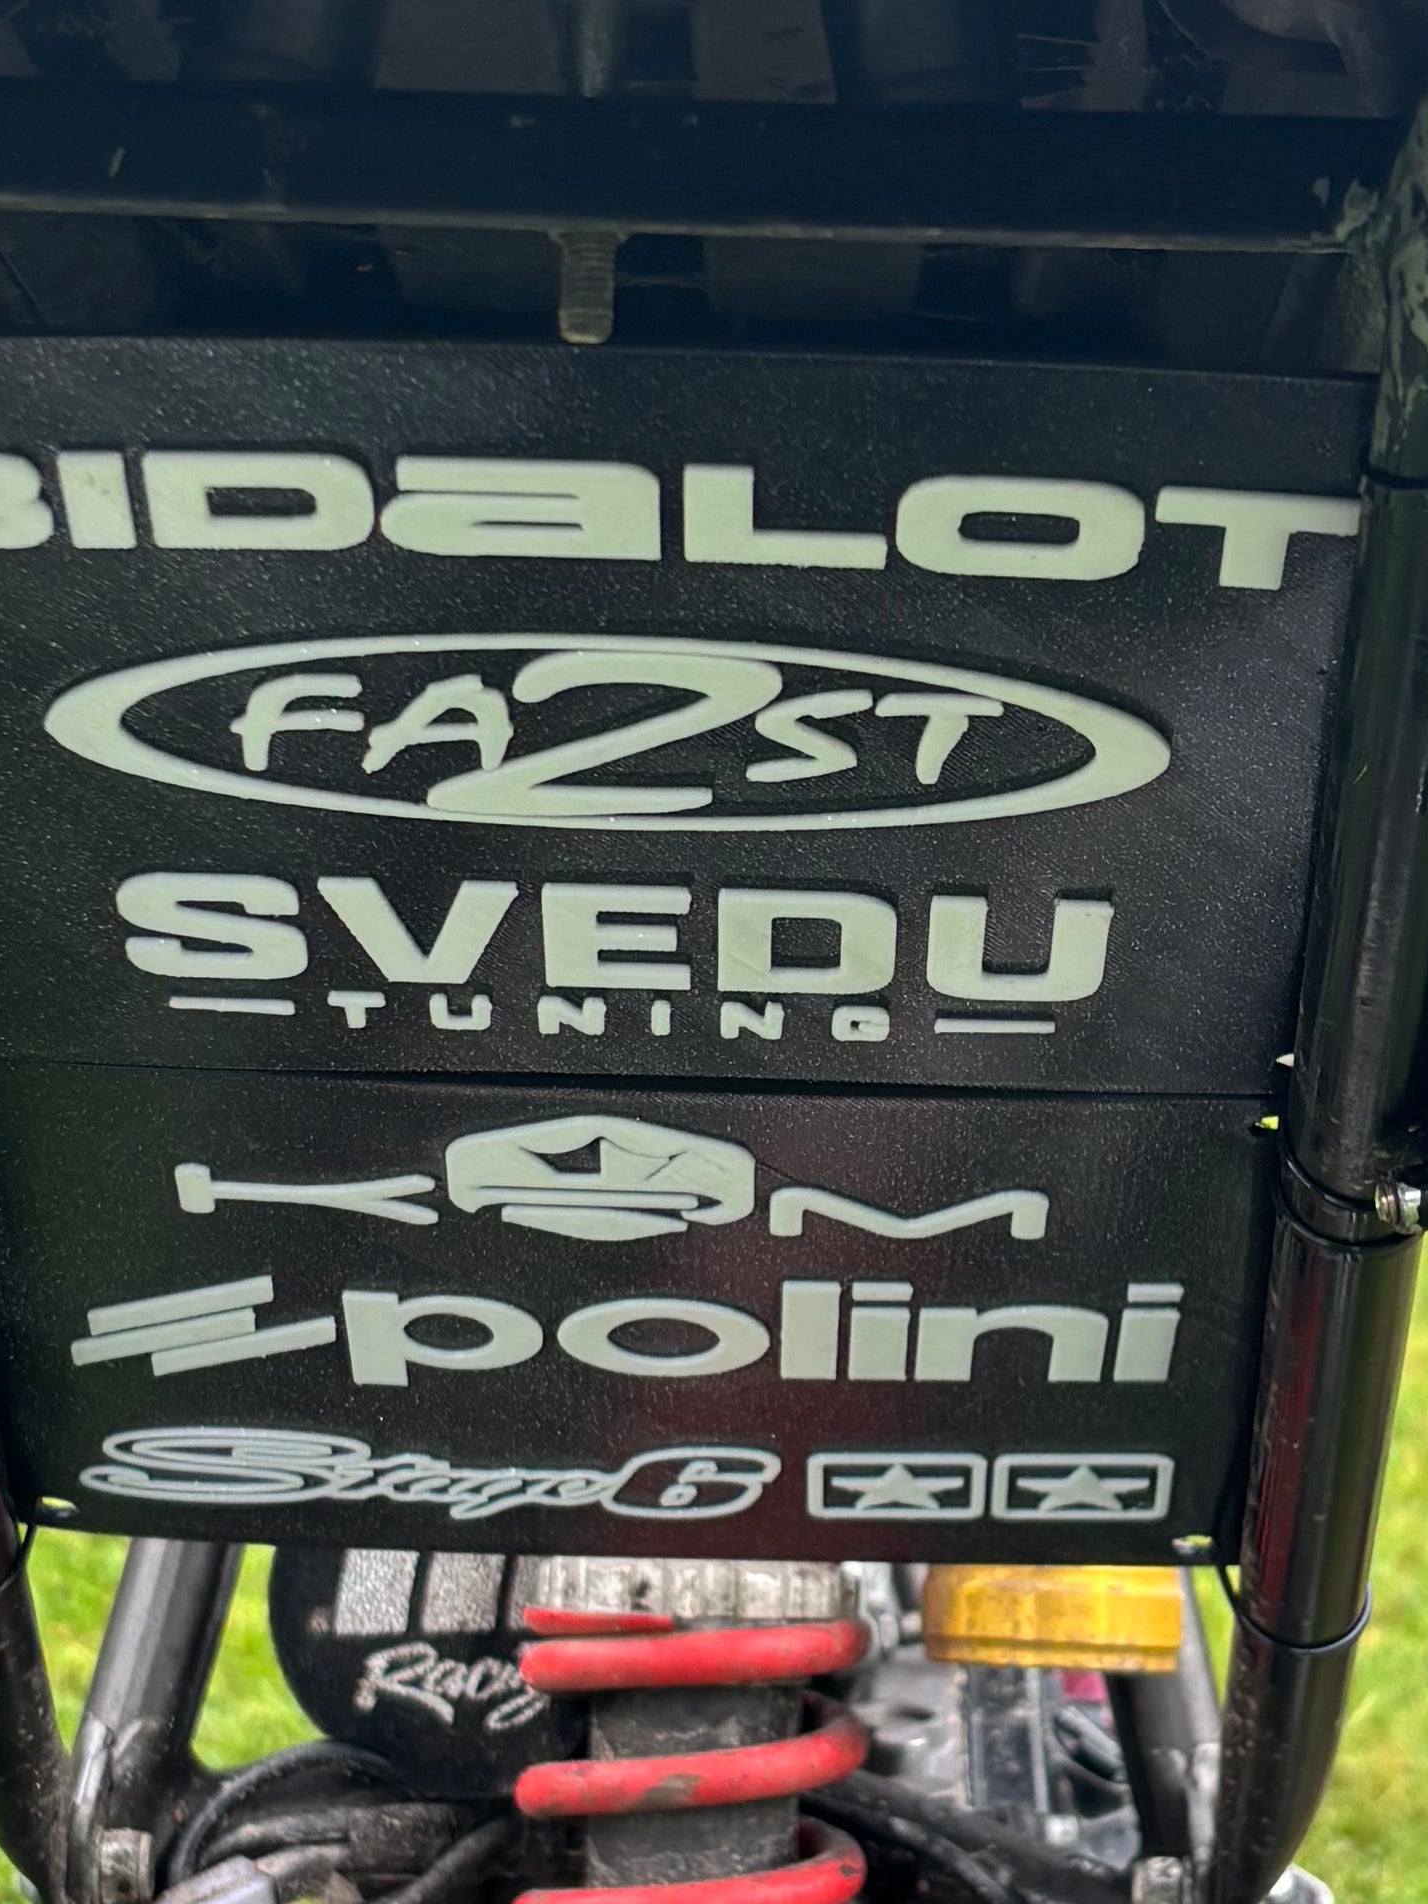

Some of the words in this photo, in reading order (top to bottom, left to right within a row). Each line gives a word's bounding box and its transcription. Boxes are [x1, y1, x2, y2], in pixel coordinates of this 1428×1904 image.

[114, 871, 1116, 1003] SVEDU
[327, 989, 892, 1043] TUNING
[341, 1279, 1186, 1388] polini
